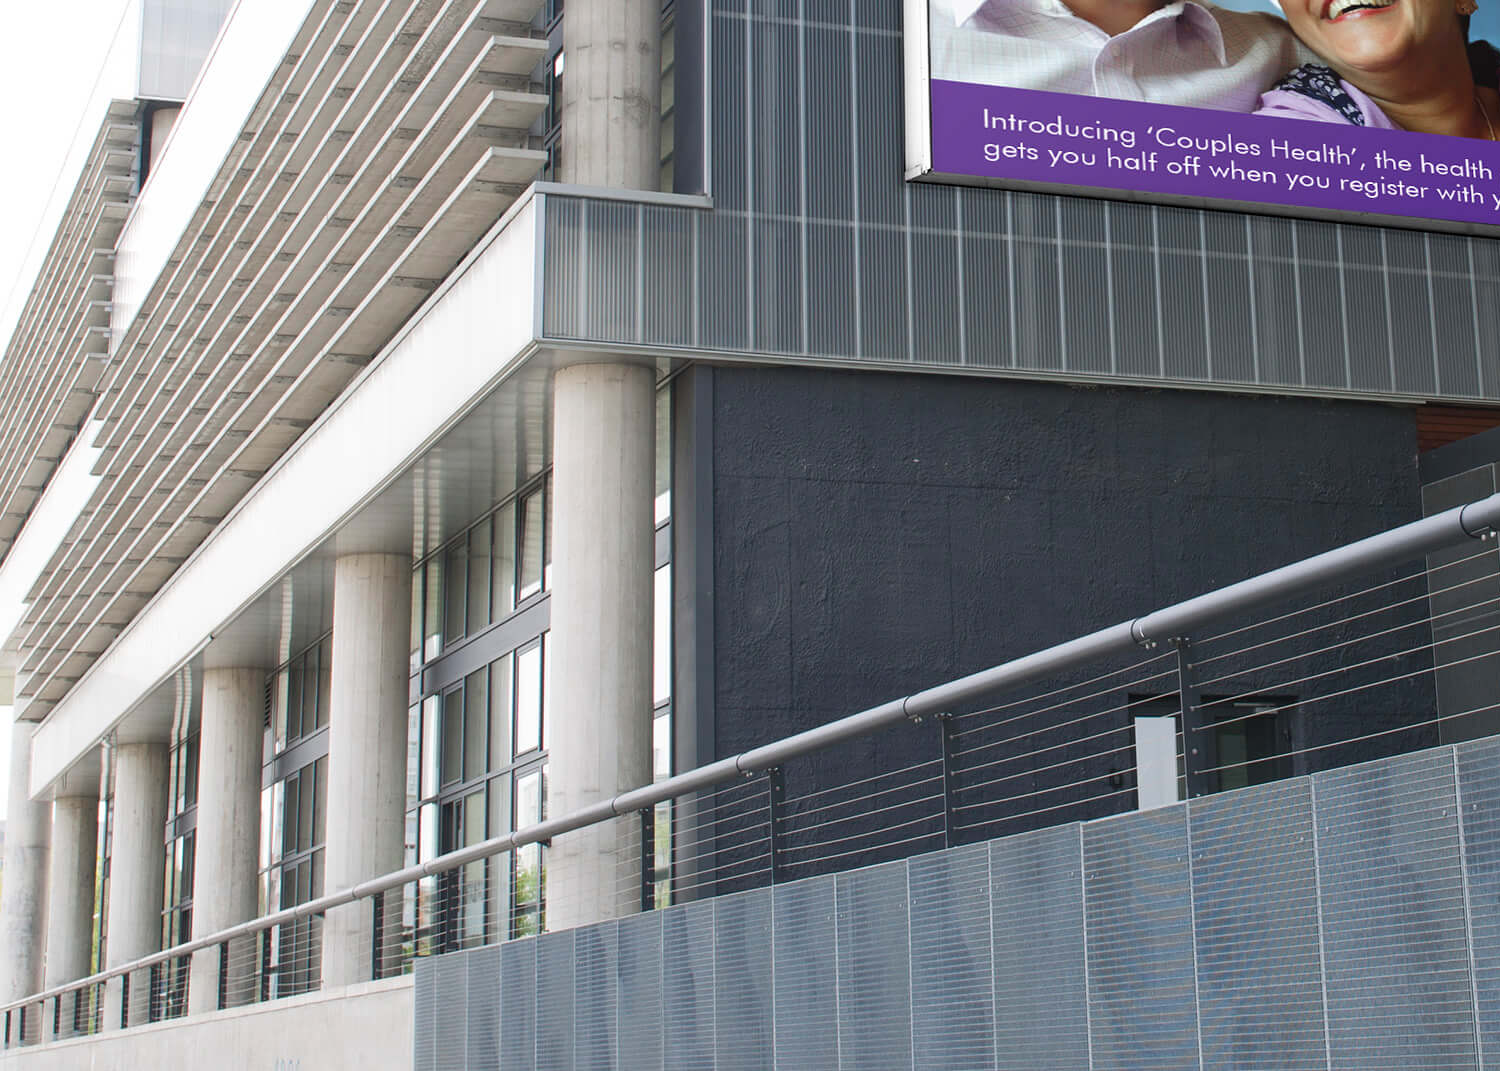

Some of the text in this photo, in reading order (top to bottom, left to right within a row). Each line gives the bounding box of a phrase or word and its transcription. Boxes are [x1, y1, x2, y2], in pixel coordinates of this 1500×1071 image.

[983, 108, 1136, 148] Introducing
[1374, 150, 1412, 171] the
[1420, 154, 1493, 180] health
[984, 141, 1038, 162] gets
[1048, 148, 1096, 167] you
[1107, 148, 1159, 172] half
[1167, 156, 1201, 176] off
[1209, 161, 1277, 183] when
[1286, 172, 1330, 191] you
[1340, 177, 1428, 199] register
[1436, 184, 1484, 205] with
